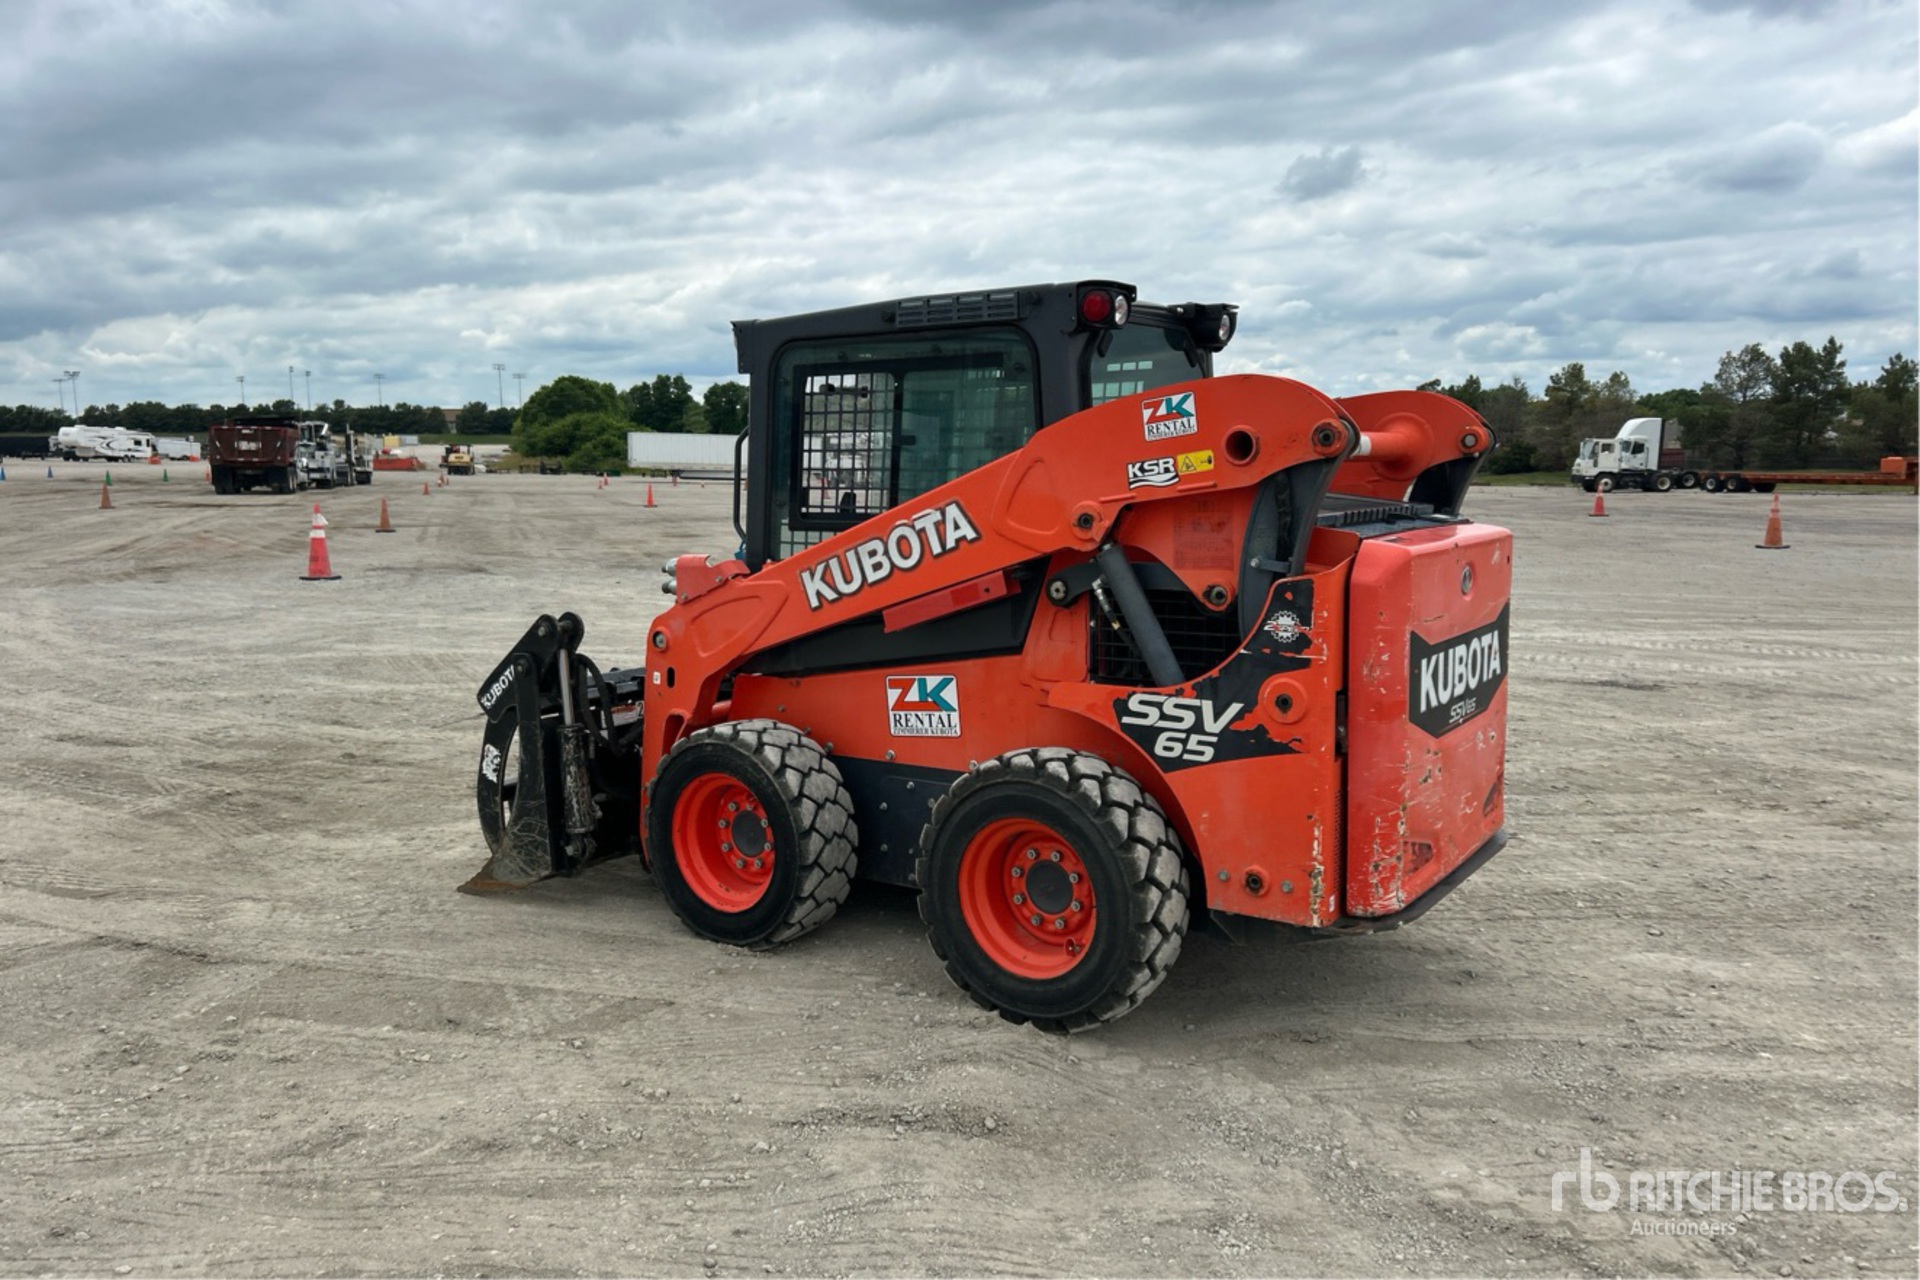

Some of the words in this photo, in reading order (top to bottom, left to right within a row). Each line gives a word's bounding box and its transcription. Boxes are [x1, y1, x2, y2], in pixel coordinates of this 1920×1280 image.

[1143, 393, 1195, 425] ZK
[1147, 418, 1195, 436] RENTAL
[1128, 458, 1175, 478] KSR
[801, 501, 979, 608] KUBOTA
[1420, 629, 1501, 714] KUBOTA
[888, 677, 957, 712] ZK
[893, 713, 957, 728] RENTAL
[1121, 692, 1244, 734] SSV
[1153, 731, 1218, 762] 65
